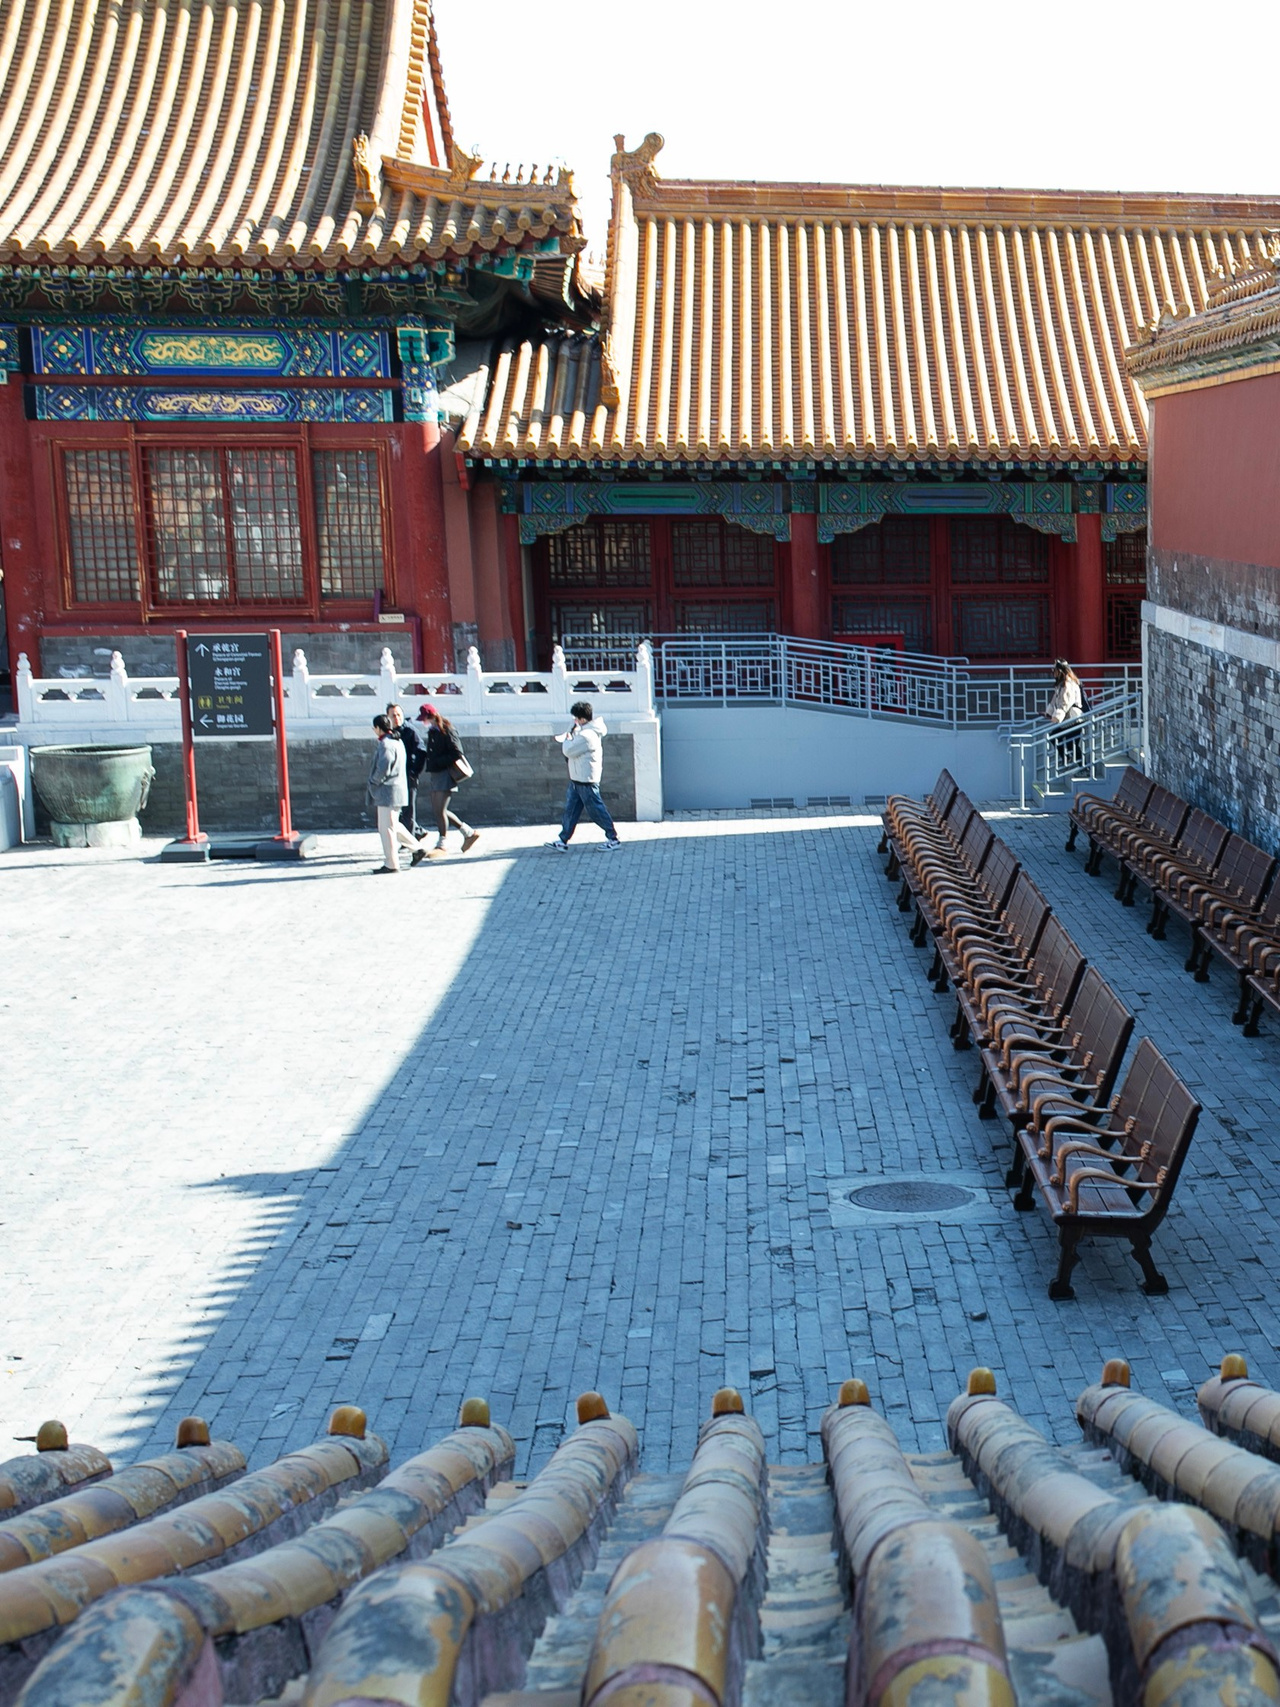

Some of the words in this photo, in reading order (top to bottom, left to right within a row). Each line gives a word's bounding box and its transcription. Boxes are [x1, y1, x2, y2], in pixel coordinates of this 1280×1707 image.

[214, 667, 241, 676] 永和宫
[216, 695, 243, 704] 卫生间
[216, 714, 244, 723] 御花园
